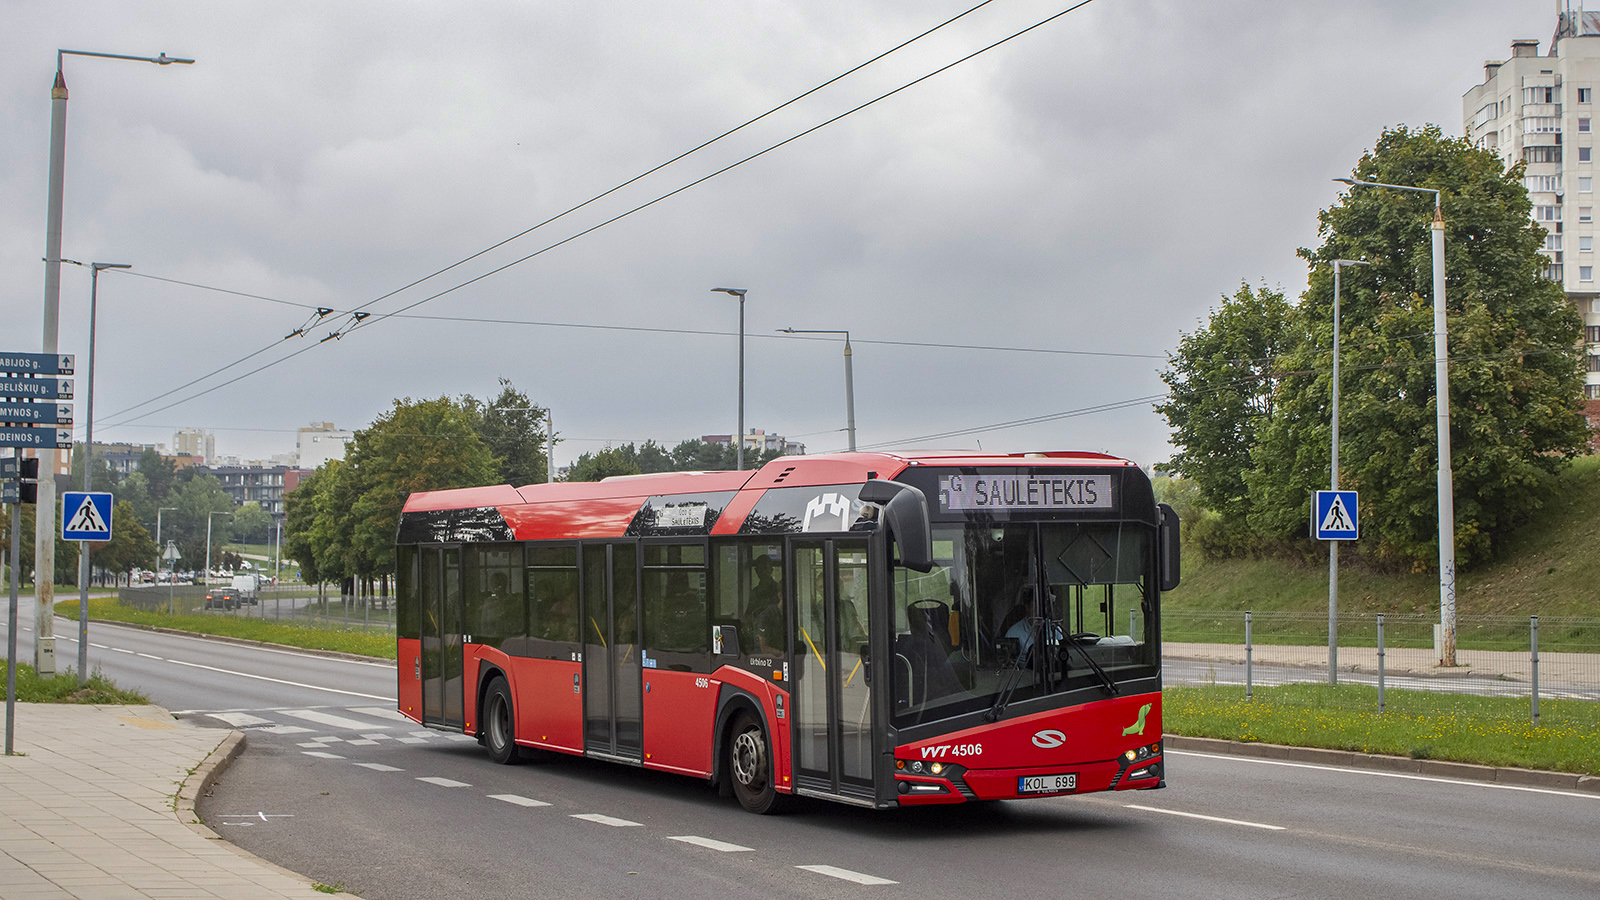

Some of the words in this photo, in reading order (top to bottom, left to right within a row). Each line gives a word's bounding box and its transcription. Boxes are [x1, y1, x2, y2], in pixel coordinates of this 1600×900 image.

[32, 360, 42, 370] g.
[41, 385, 49, 395] g.
[33, 410, 42, 419] g.
[34, 435, 43, 444] g.
[975, 475, 1098, 506] SAULĖTEKIS
[750, 658, 767, 667] Urbino
[766, 658, 773, 668] 12
[695, 677, 709, 689] 4506
[951, 743, 983, 757] 4506
[1025, 778, 1048, 790] KOL
[1055, 776, 1075, 788] 699
